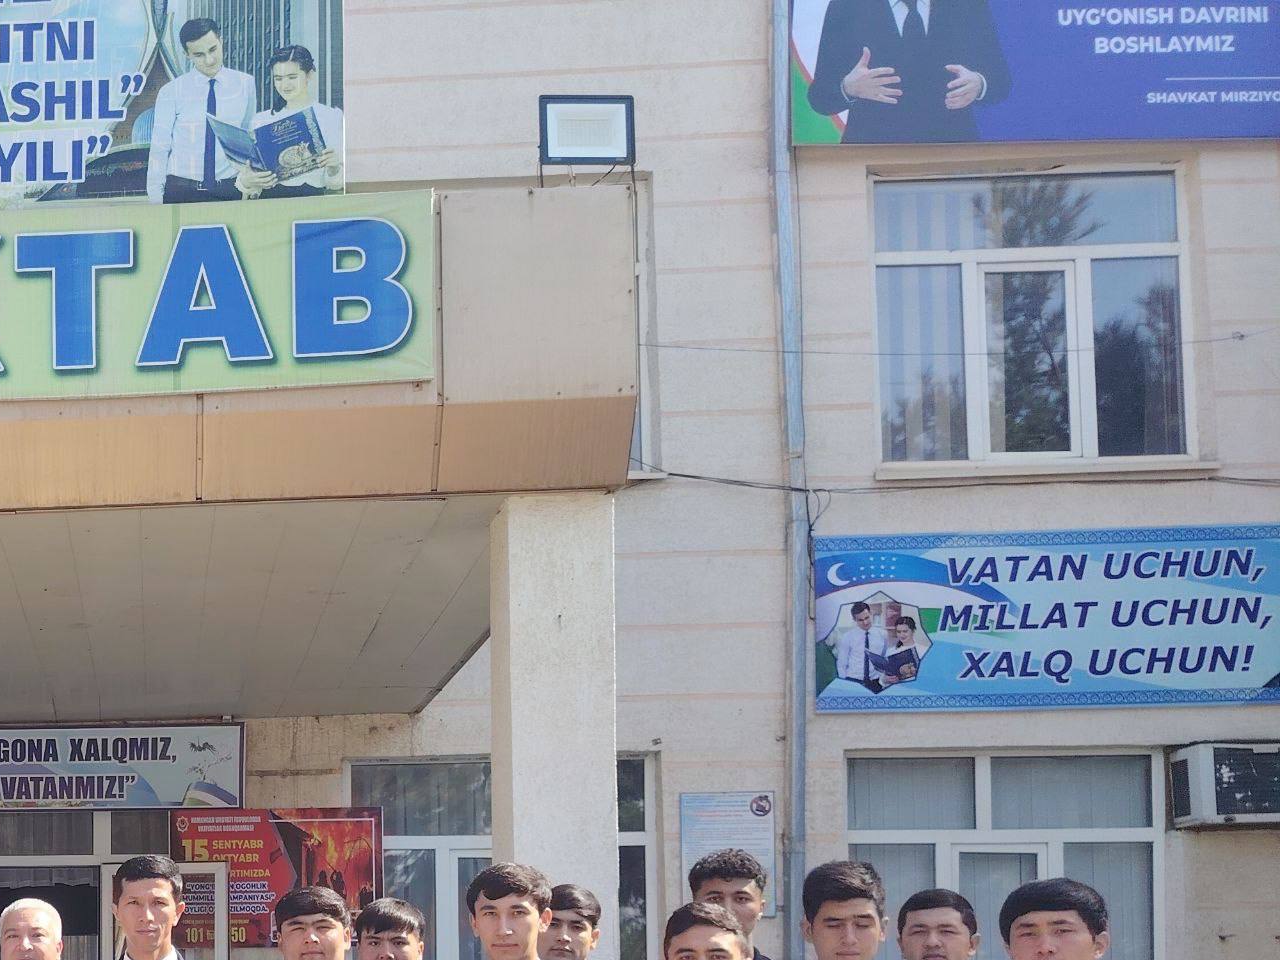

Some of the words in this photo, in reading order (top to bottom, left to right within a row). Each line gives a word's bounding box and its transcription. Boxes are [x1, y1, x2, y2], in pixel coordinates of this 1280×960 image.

[1179, 6, 1269, 24] DAVRINI
[1094, 34, 1236, 54] BOSHLAYMIZ
[1146, 91, 1218, 104] SHAVKAT
[947, 553, 1089, 585] VATAN
[1102, 548, 1267, 582] UCHUN,
[938, 601, 1099, 633] MILLAT
[1110, 597, 1273, 631] UCHUN,
[959, 650, 1074, 684] XALQ
[1088, 645, 1256, 676] UCHUN!
[69, 736, 177, 764] XALQMIZ,
[0, 775, 136, 800] VATANMIZ!”
[181, 838, 210, 862] 15
[212, 839, 265, 850] SENTYABR
[212, 853, 260, 863] OKTYABR
[229, 869, 271, 878] RTIMIZDA
[236, 881, 268, 890] OGOHLIK
